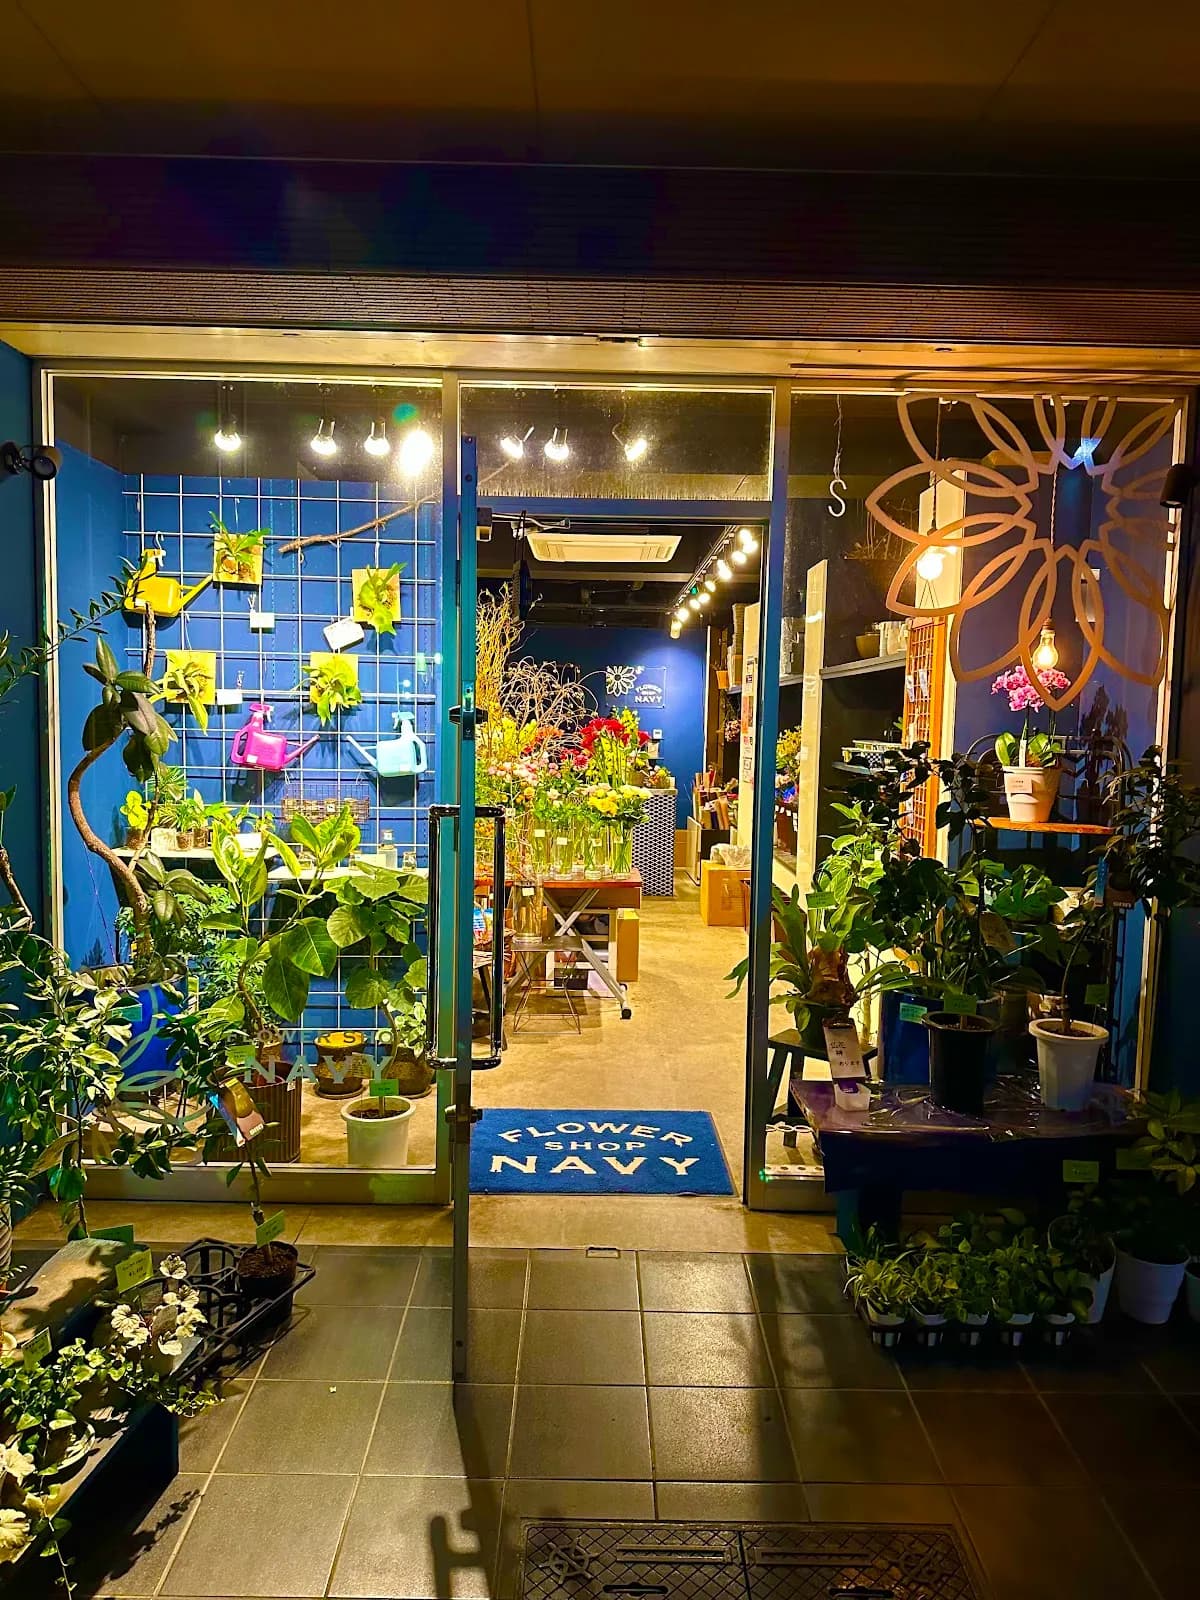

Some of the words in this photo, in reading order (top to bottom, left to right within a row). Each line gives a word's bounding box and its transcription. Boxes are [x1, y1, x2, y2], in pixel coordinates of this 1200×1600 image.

[243, 1055, 394, 1084] NAVY
[498, 1122, 693, 1147] FLOWER
[545, 1141, 646, 1151] SHOP
[490, 1155, 700, 1175] NAVY
